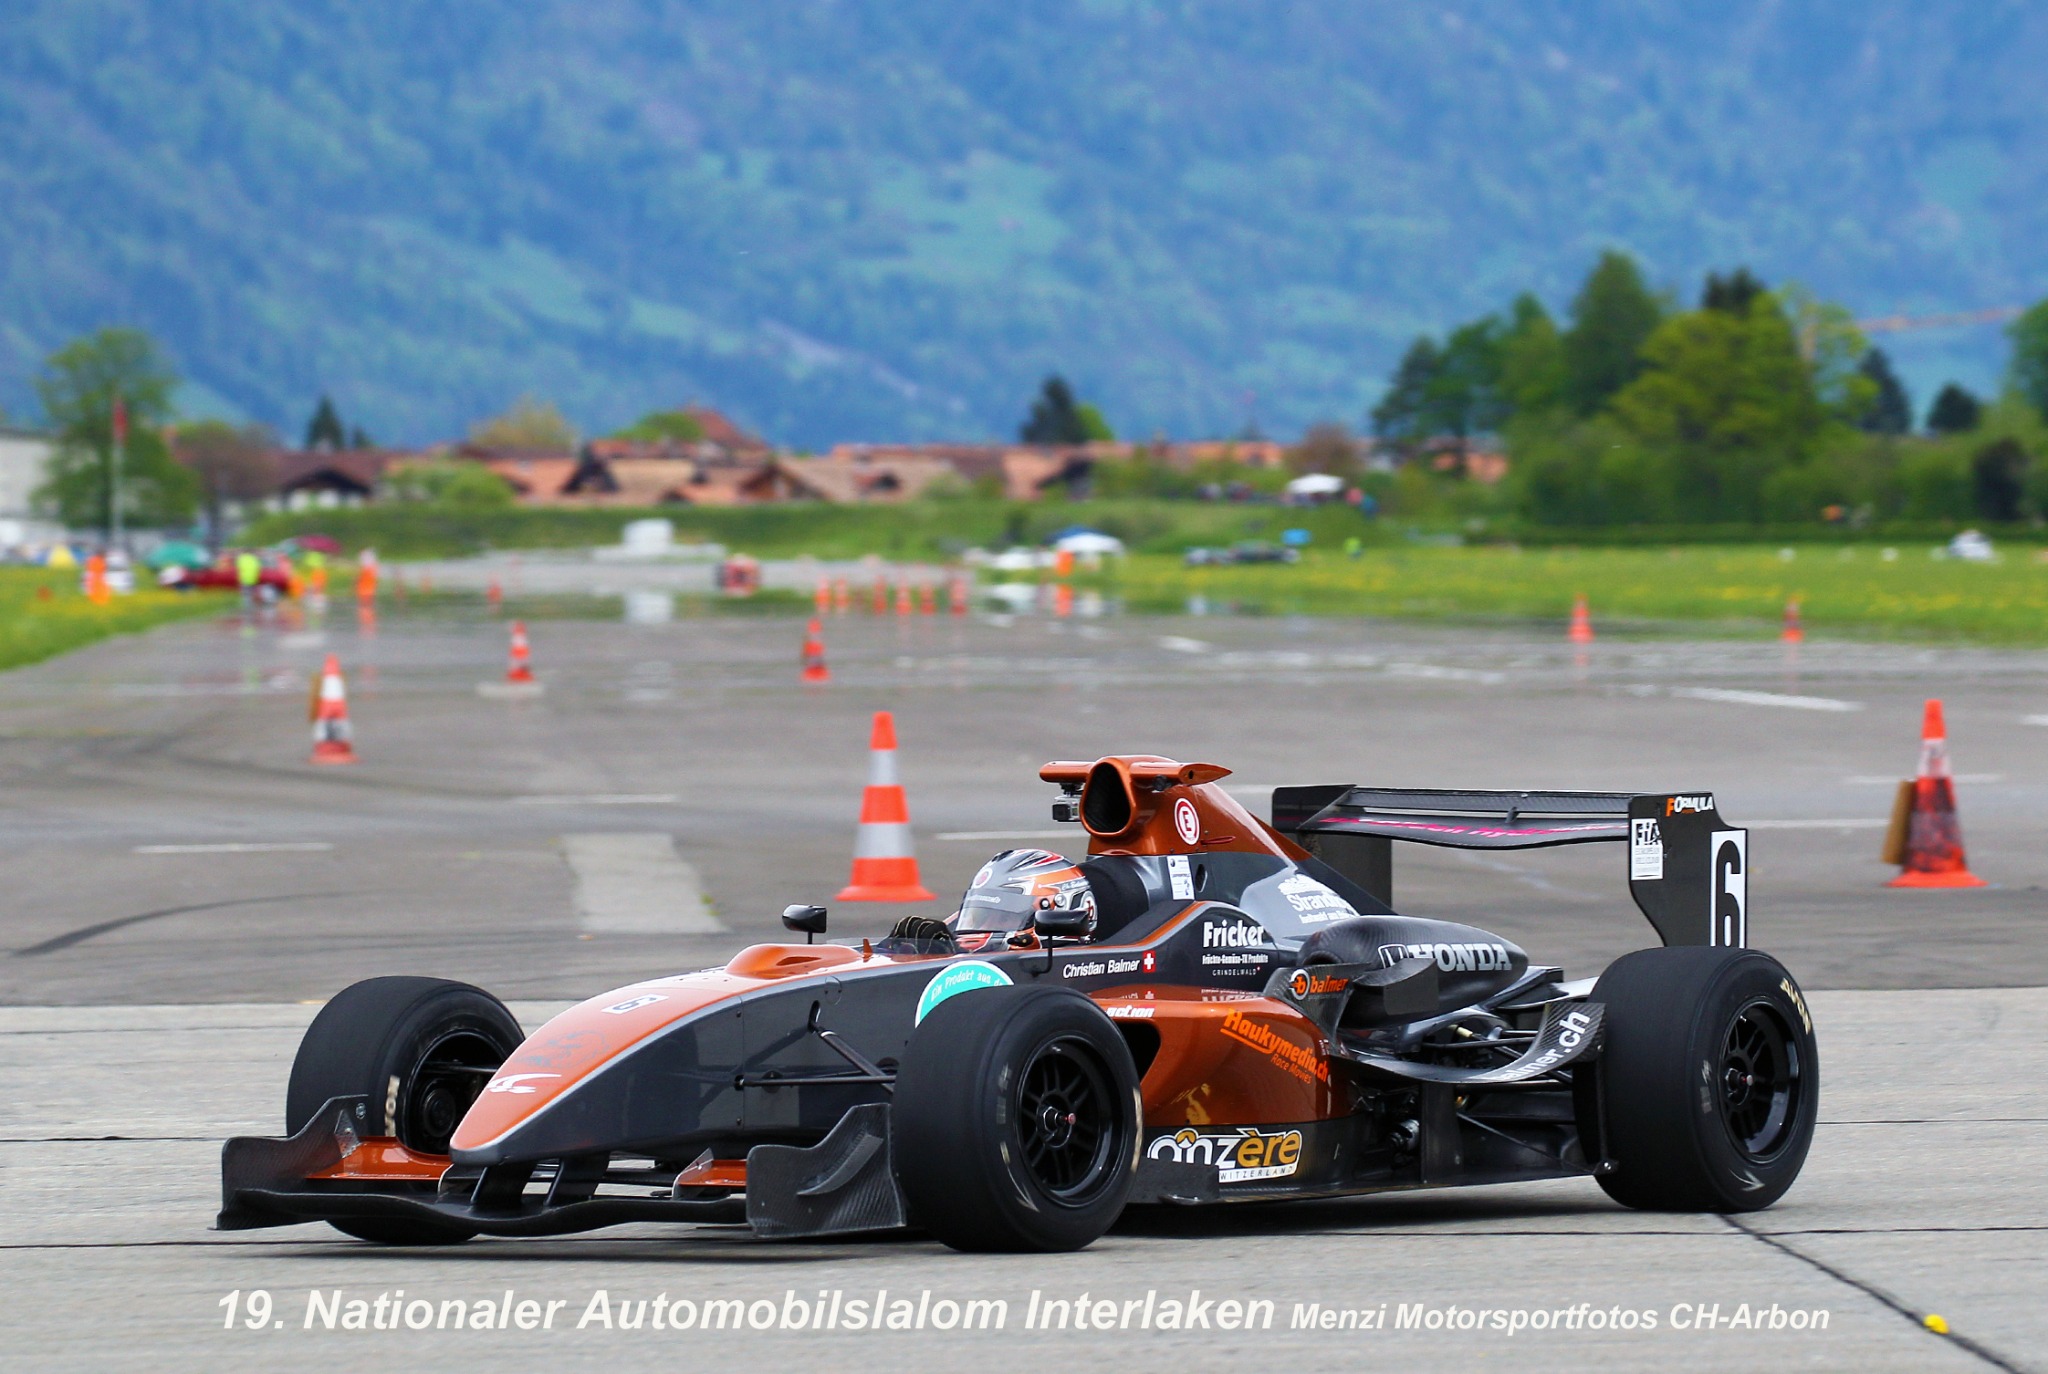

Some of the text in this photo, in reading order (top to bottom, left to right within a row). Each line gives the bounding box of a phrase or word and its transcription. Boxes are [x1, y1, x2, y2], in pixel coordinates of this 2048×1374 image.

[1665, 796, 1714, 817] FORMULA
[1716, 839, 1741, 947] 6
[1203, 919, 1264, 948] Fricker
[945, 970, 975, 989] Produkt
[1063, 959, 1140, 978] Christian Balmer
[1309, 975, 1349, 994] balmer
[1500, 1012, 1590, 1079] almer.ch
[1270, 1053, 1312, 1085] Race Movies
[1151, 1130, 1300, 1169] anzère
[1220, 1167, 1294, 1180] WITZERLAND
